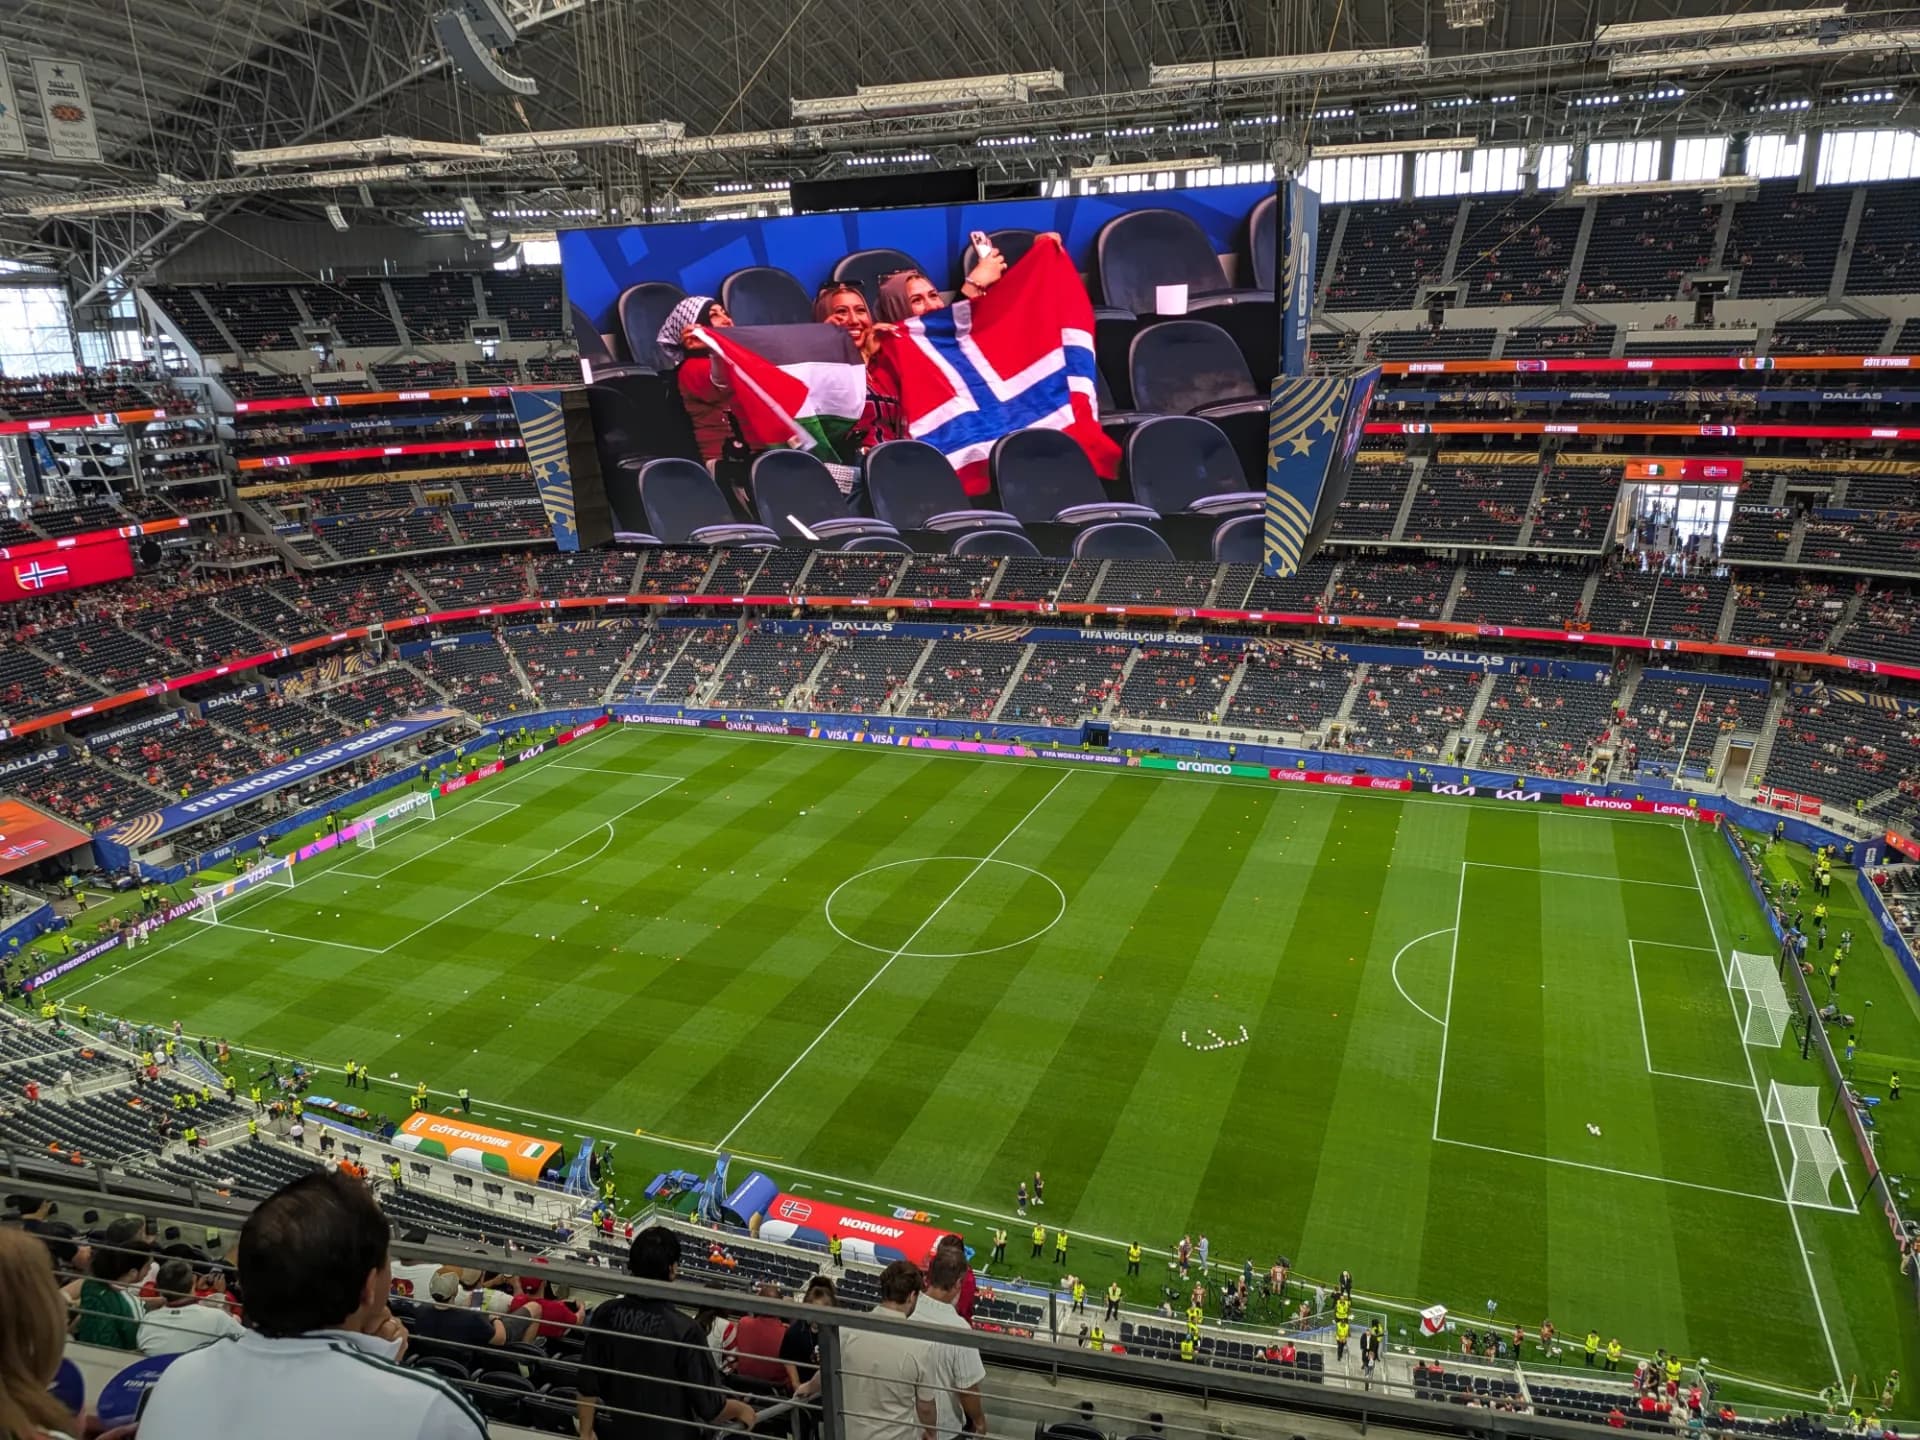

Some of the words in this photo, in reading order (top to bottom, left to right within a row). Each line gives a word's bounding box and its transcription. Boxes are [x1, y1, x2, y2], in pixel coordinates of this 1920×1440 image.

[1822, 392, 1883, 400] DALLAS
[351, 419, 391, 429] DALLAS
[832, 621, 893, 632] DALLAS
[1080, 630, 1102, 640] FIFA
[1104, 631, 1143, 641] WORLD
[1143, 632, 1165, 643] CUP
[1165, 634, 1204, 645] 2026
[1424, 651, 1505, 666] DALLAS
[207, 686, 258, 709] DALLAS
[624, 714, 644, 723] ADI
[92, 734, 109, 745] FIFA
[108, 724, 137, 740] WORLD
[137, 720, 153, 732] CUP
[152, 711, 179, 726] 2026
[572, 723, 595, 740] Lenovo
[725, 721, 752, 732] QATAR
[754, 724, 789, 735] AIRWAYS
[825, 729, 850, 741] VISA
[870, 733, 894, 745] VISA
[0, 749, 59, 777] DALLAS
[1056, 752, 1081, 760] WORLD
[1081, 753, 1095, 761] CUP
[181, 788, 236, 813] FIFA
[235, 763, 307, 793] WORLD
[304, 747, 344, 766] CUP
[341, 724, 407, 751] 2026
[1176, 760, 1232, 775] aramco
[387, 792, 430, 819] aramco
[1585, 796, 1632, 810] Lenovo
[1654, 803, 1696, 817] Lenov
[213, 846, 232, 859] FIFA
[247, 864, 273, 884] VISA
[32, 969, 58, 988] ADI
[57, 935, 120, 975] PREDICTSTREET
[429, 1123, 461, 1138] CÔTE
[459, 1131, 513, 1148] D'IVOIRE
[838, 1216, 904, 1239] NORWAY
